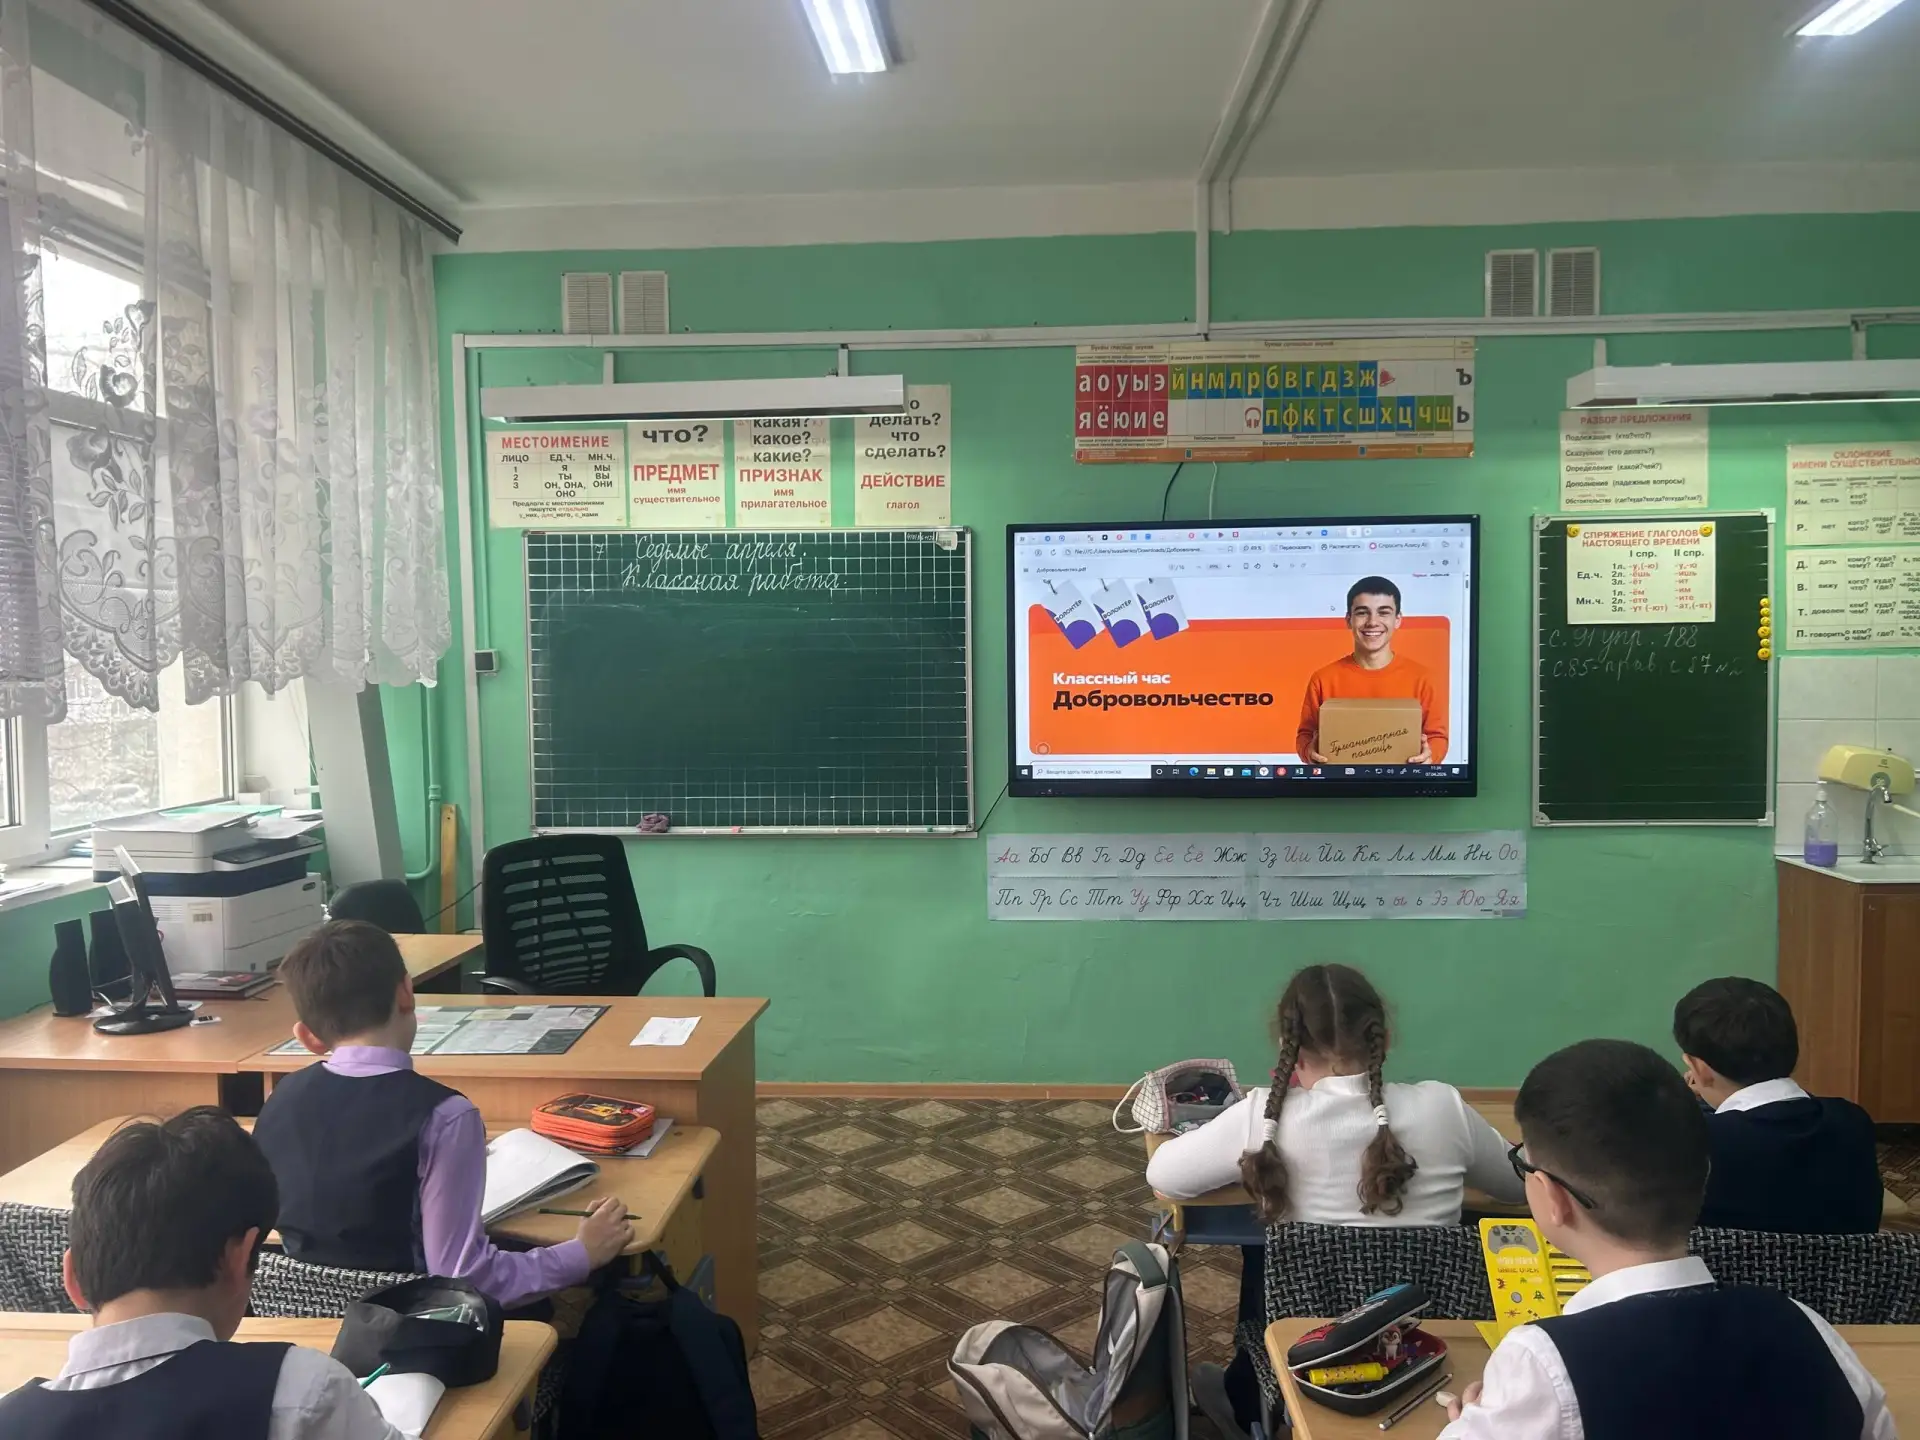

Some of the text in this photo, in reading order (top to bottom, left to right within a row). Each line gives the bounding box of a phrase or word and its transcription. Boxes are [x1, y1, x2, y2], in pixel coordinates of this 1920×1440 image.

[869, 413, 941, 427] делать?
[1580, 413, 1691, 425] РАЗБОР ПРЕДЛОЖЕНИЯ
[642, 424, 709, 443] что?
[753, 431, 812, 445] какое?
[891, 431, 920, 442] что
[501, 436, 610, 449] МЕСТОИМЕНИЕ
[753, 448, 812, 463] какие?
[865, 445, 946, 459] сделать?
[1833, 449, 1893, 459] СКЛОНЕНИЕ
[501, 453, 616, 464] ЛИЦО ЕД.Ч. МН.Ч.
[595, 472, 610, 480] ВЫ
[633, 463, 720, 485] ПРЕДМЕТ
[739, 468, 823, 483] ПРИЗНАК
[544, 482, 561, 490] ОН,
[564, 481, 586, 490] ОНА,
[860, 472, 946, 489] ДЕЙСТВИЕ
[555, 490, 576, 498] ОНО
[773, 489, 794, 497] имя
[633, 495, 721, 505] существительное
[740, 500, 827, 510] прилагательное
[886, 501, 920, 509] глагол
[1583, 529, 1698, 539] СПРЯЖЕНИЕ ГЛАГОЛОВ
[1582, 538, 1700, 548] НАСТОЯЩЕГО ВРЕМЕНИ
[1636, 551, 1658, 559] спр.
[1683, 550, 1705, 558] спр.
[1577, 571, 1603, 579] Ед.ч.
[1052, 671, 1172, 685] Классный час
[1052, 689, 1274, 711] Добровольчество
[1329, 728, 1409, 757] Гуманитарная
[1351, 743, 1392, 760] помощь
[994, 843, 1518, 870] Аа Бб Вв Гг Дд Ее Ёё Жж Зз Ии Йй Кк Лл Мм Нн Оо
[995, 888, 1023, 906] Пп
[1029, 888, 1053, 913] Рр
[1059, 888, 1078, 906] Сс
[1085, 888, 1124, 906] Тт
[1130, 888, 1150, 913] Уу
[1155, 888, 1182, 912] Фф
[1187, 889, 1215, 906] Хх
[1220, 889, 1247, 909] Цц
[1259, 890, 1282, 907] Чч
[1290, 890, 1324, 907] Шш
[1332, 890, 1367, 910] Щщ
[1430, 890, 1448, 907] Ээ
[1455, 889, 1486, 907] Юю
[1493, 889, 1520, 907] Яя
